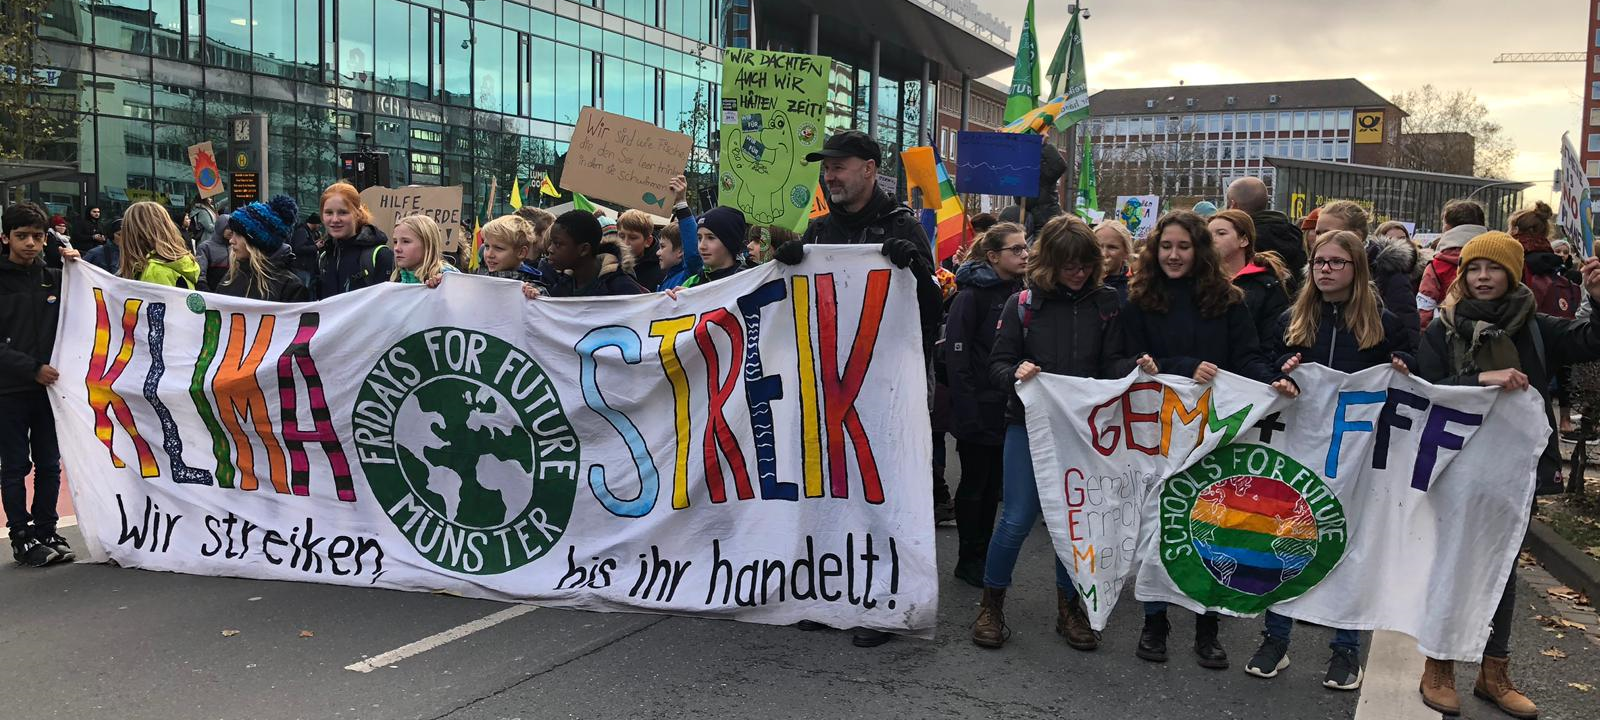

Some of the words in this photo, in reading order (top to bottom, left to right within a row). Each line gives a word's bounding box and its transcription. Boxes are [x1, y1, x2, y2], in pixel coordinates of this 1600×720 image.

[735, 67, 767, 90] AUCH
[760, 53, 822, 77] DACHTEN
[740, 90, 778, 110] HÄTTEN
[586, 113, 610, 139] Wir
[616, 128, 636, 146] sind
[636, 137, 652, 150] wie
[598, 142, 615, 160] den
[380, 194, 424, 210] HILFE,
[1563, 183, 1578, 219] NO
[85, 287, 356, 502] KLIMA
[574, 269, 892, 518] STREIK
[354, 346, 421, 465] FRIDAYS
[424, 330, 487, 374] FOR
[494, 349, 576, 480] FUTURE
[1325, 387, 1483, 492] FFF
[1164, 454, 1222, 561] SCHOOLS
[1233, 447, 1286, 482] FOR
[1289, 466, 1344, 544] FUTURE
[387, 492, 563, 572] MÜNSTER
[116, 494, 182, 553] Wir
[201, 511, 388, 584] streiken,
[553, 545, 616, 590] bis
[629, 545, 692, 603] ihr
[705, 533, 899, 610] handelt!
